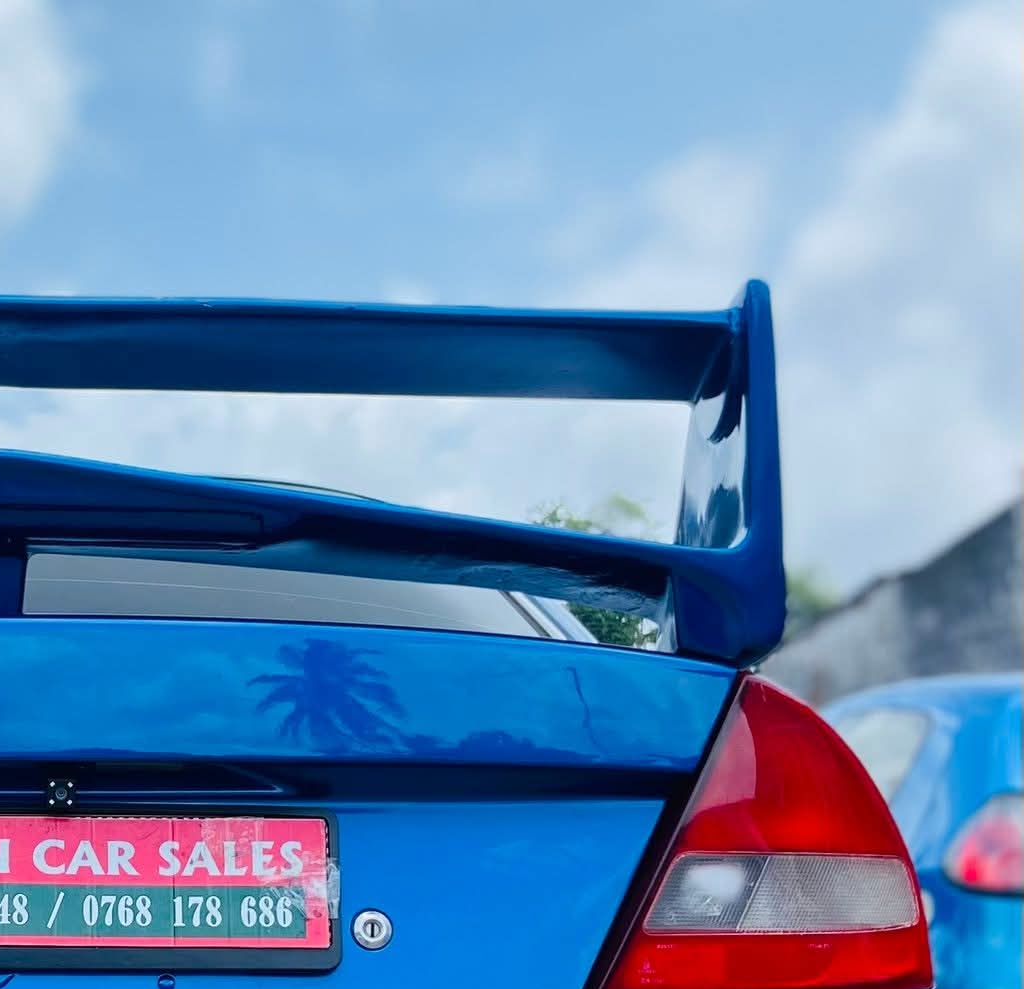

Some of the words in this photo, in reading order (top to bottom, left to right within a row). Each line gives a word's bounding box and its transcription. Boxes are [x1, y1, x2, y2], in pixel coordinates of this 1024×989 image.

[32, 838, 140, 876] CAR
[158, 840, 304, 876] SALES
[46, 891, 65, 929] /
[82, 894, 152, 927] 0768
[173, 896, 222, 927] 178
[240, 895, 294, 927] 686
